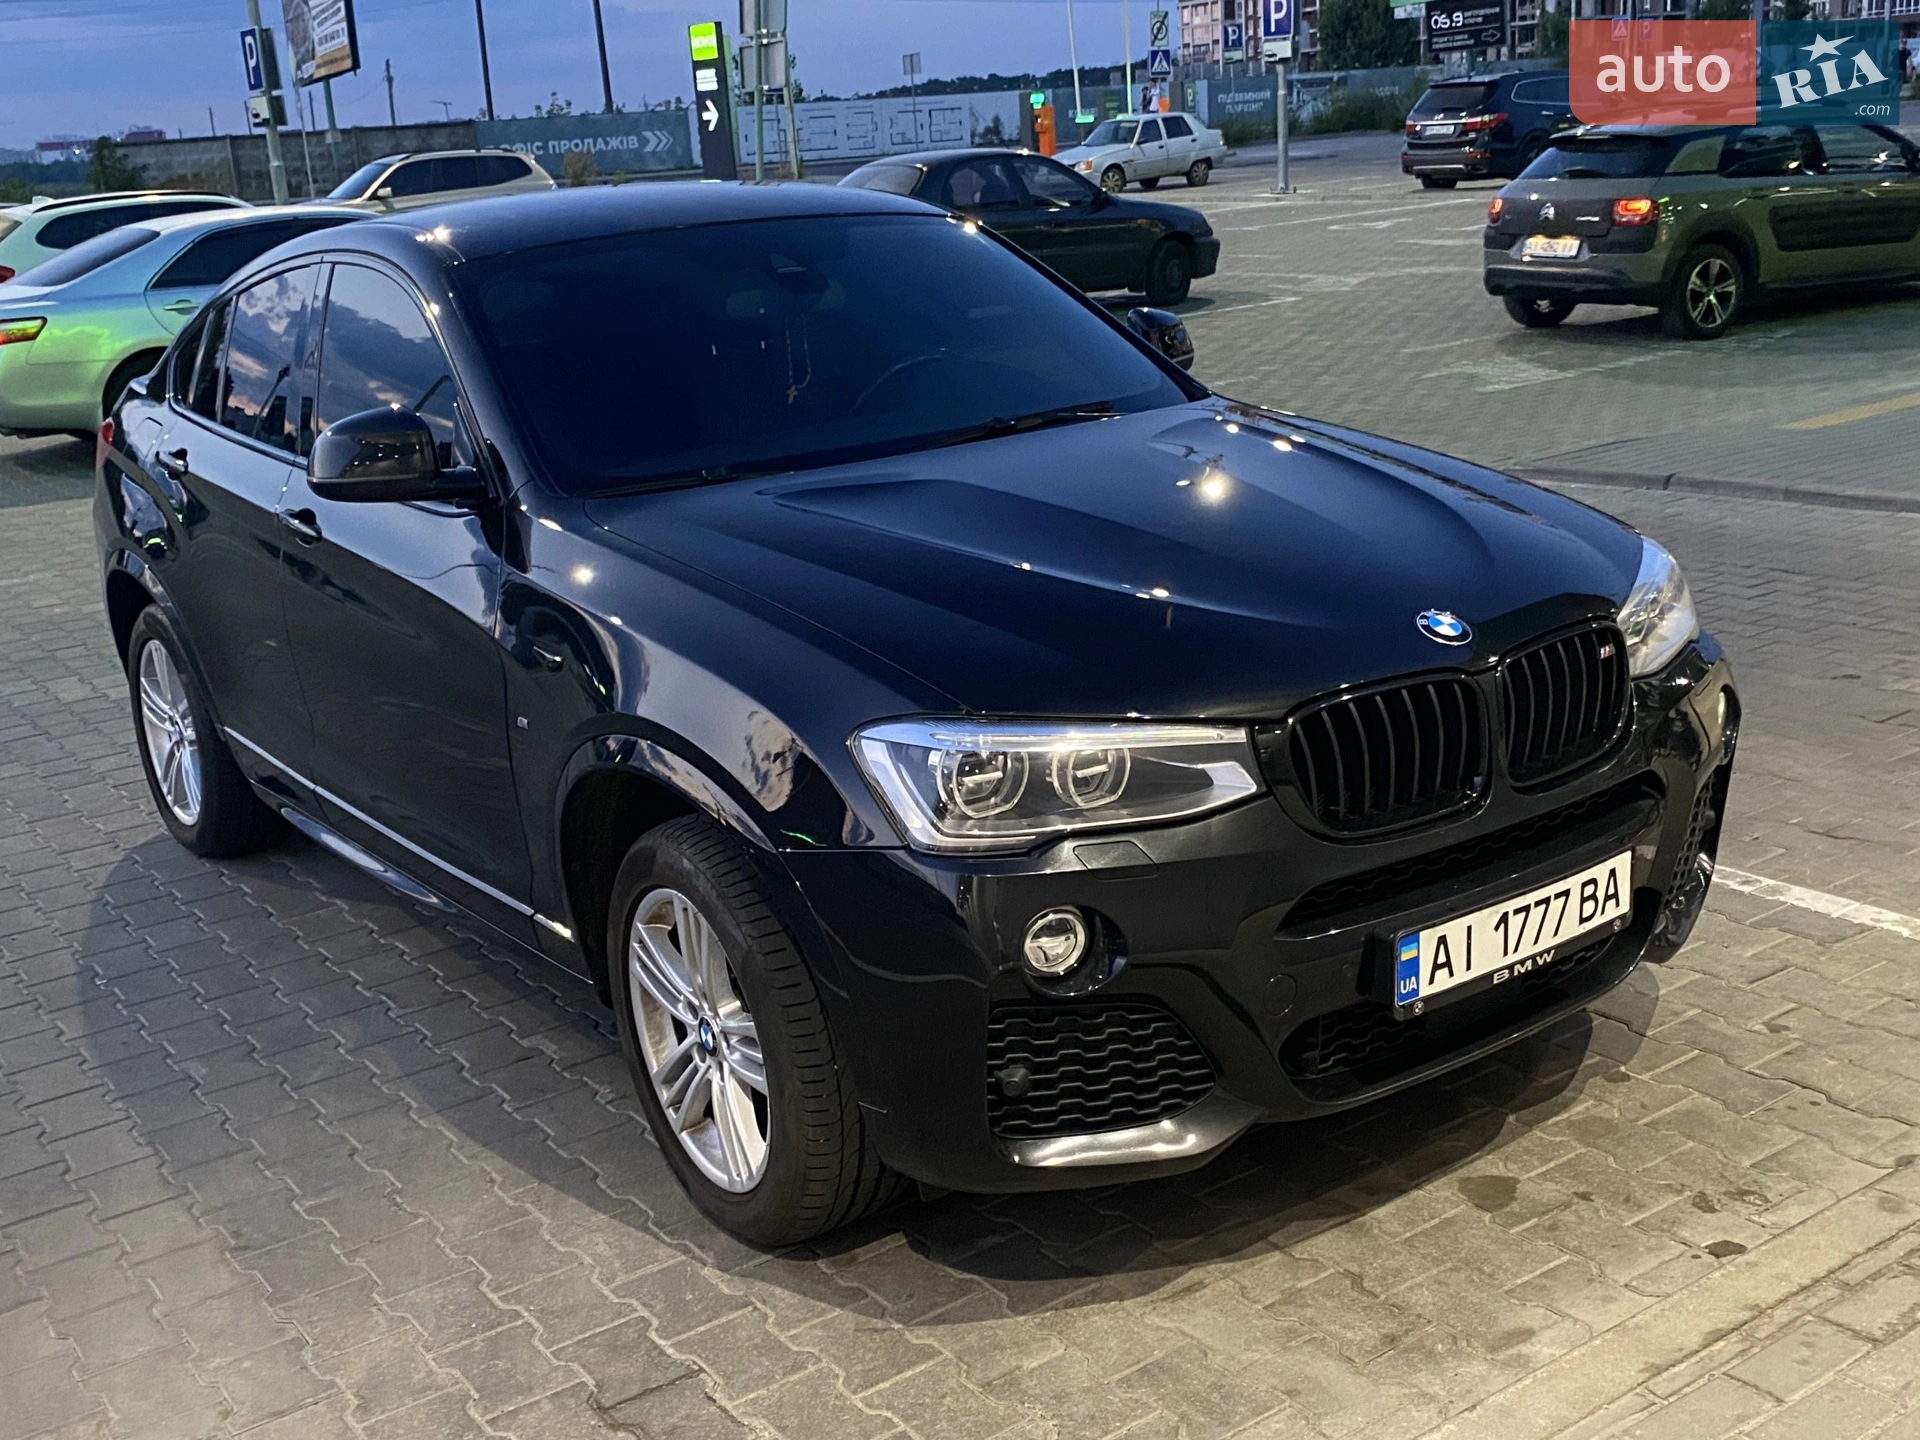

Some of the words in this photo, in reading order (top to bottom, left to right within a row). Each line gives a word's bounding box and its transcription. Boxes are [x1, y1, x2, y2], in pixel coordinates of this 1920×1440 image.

[1270, 0, 1287, 32] P
[1228, 27, 1239, 46] P
[244, 35, 257, 85] P
[549, 135, 639, 154] ПРОДАЖІВ
[1428, 925, 1472, 986] AI
[1494, 888, 1571, 958] 1777
[1578, 867, 1620, 927] BA
[1492, 950, 1556, 985] BMW
[1400, 976, 1418, 994] UA
